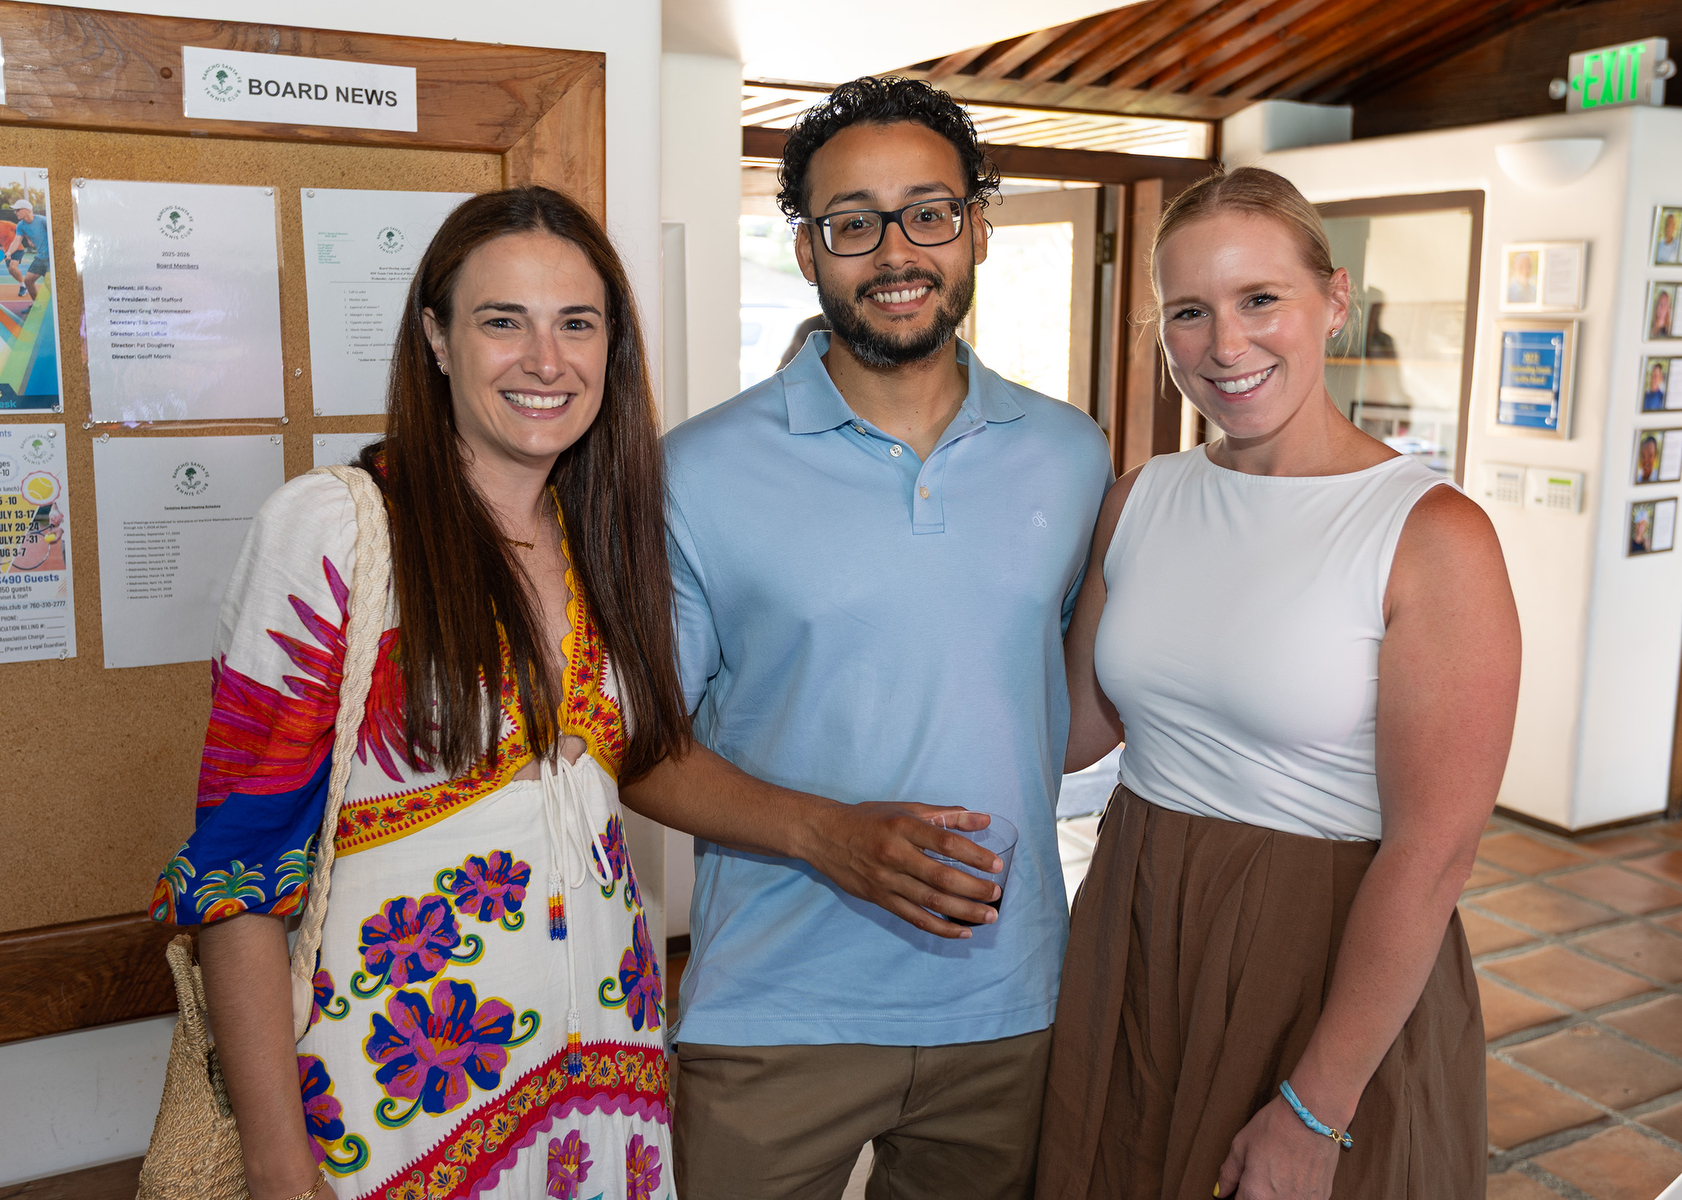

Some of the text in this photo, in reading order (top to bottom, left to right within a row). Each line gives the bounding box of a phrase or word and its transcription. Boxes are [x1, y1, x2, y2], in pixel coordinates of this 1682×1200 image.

[202, 63, 220, 80] RANCHO
[222, 64, 238, 75] SANTA
[1582, 44, 1646, 108] EXIT
[205, 87, 241, 102] TENNIS CLUB
[248, 79, 397, 107] BOARD NEWS
[157, 206, 173, 221] RANCHO
[175, 206, 189, 216] SANTA
[160, 228, 192, 240] TENNIS CLUB
[172, 462, 189, 478] RANCHO
[191, 462, 205, 471] SANTA
[175, 483, 209, 496] TENNIS CLUB
[15, 510, 35, 519] 13-17
[15, 522, 39, 532] 20-24
[16, 535, 38, 544] 27-31
[13, 548, 26, 557] 3-7
[24, 574, 59, 583] Guests
